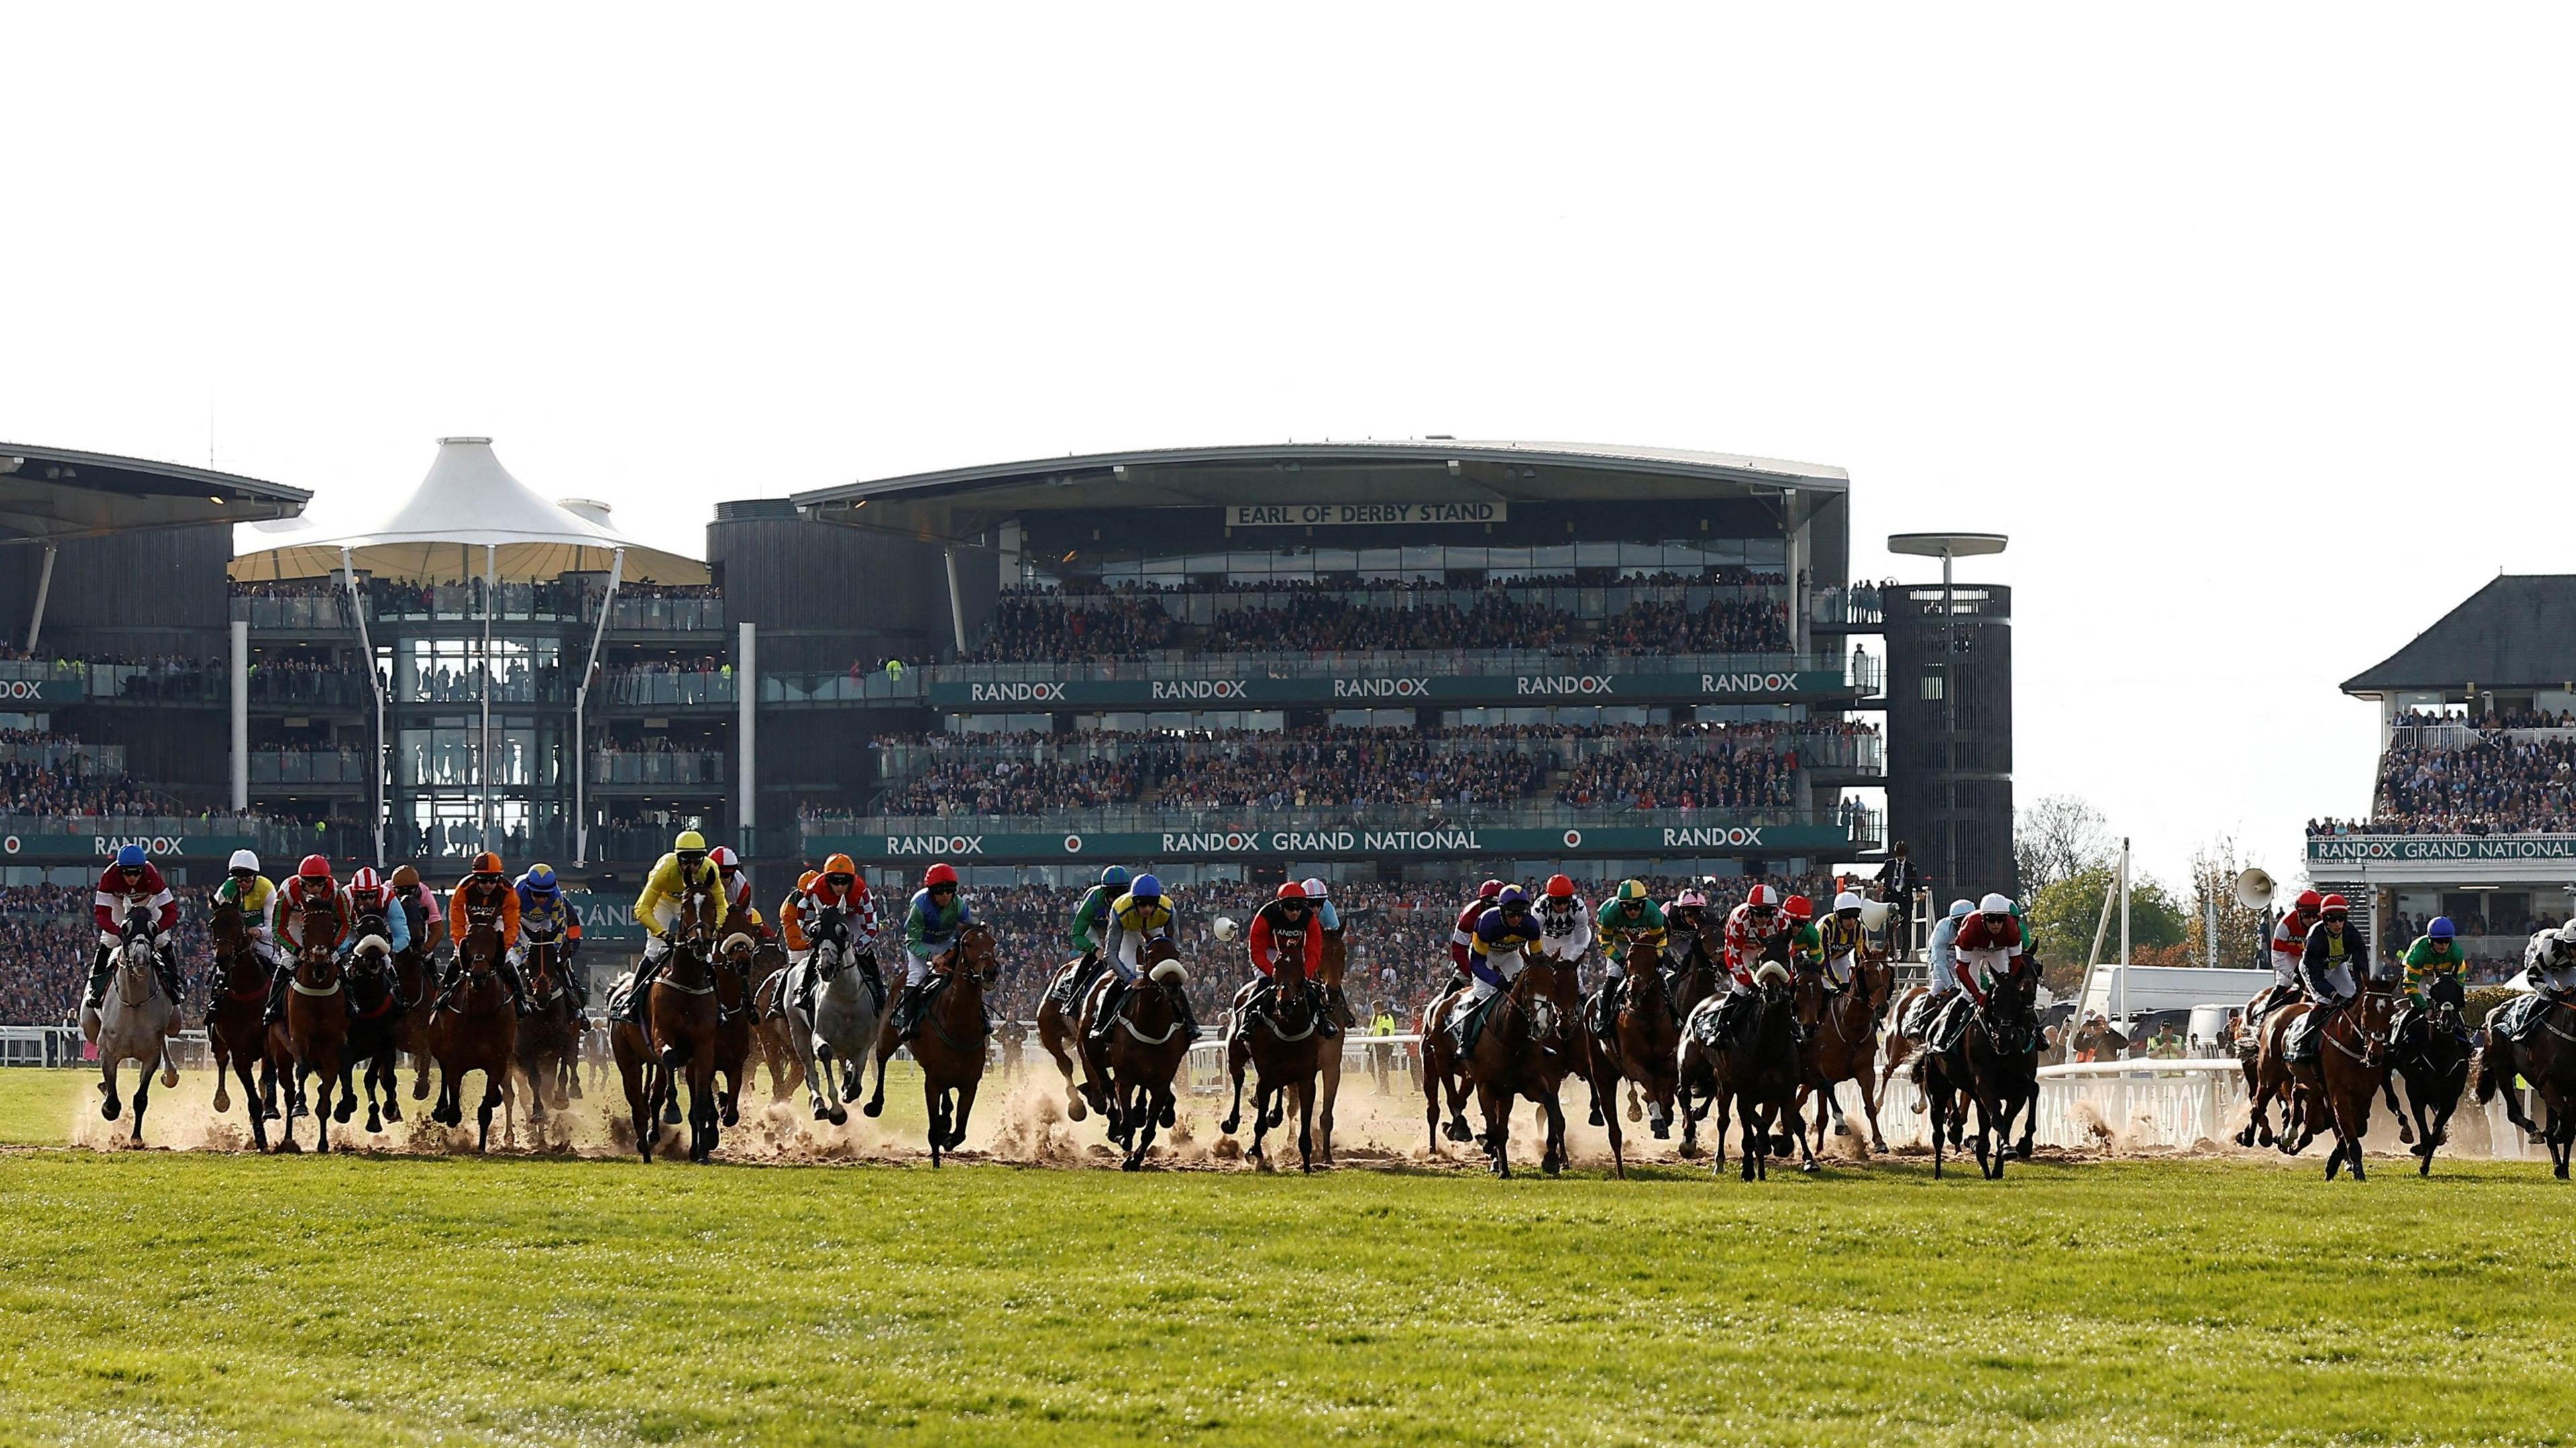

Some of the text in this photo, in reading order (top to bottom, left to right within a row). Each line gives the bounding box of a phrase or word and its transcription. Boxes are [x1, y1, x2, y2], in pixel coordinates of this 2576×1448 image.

[1239, 503, 1494, 524] EARL OF DERBY STAND
[972, 682, 1065, 701] RANDOX
[1152, 680, 1246, 699] RANDOX
[1334, 678, 1429, 697] RANDOX
[1517, 675, 1613, 694] RANDOX
[1702, 673, 1799, 692] RANDOX
[888, 836, 983, 854] RANDOX
[1163, 830, 1481, 852] RANDOX GRAND NATIONAL
[1664, 827, 1762, 846] RANDOX
[2318, 841, 2575, 858] RANDOX GRAND NATIONAL
